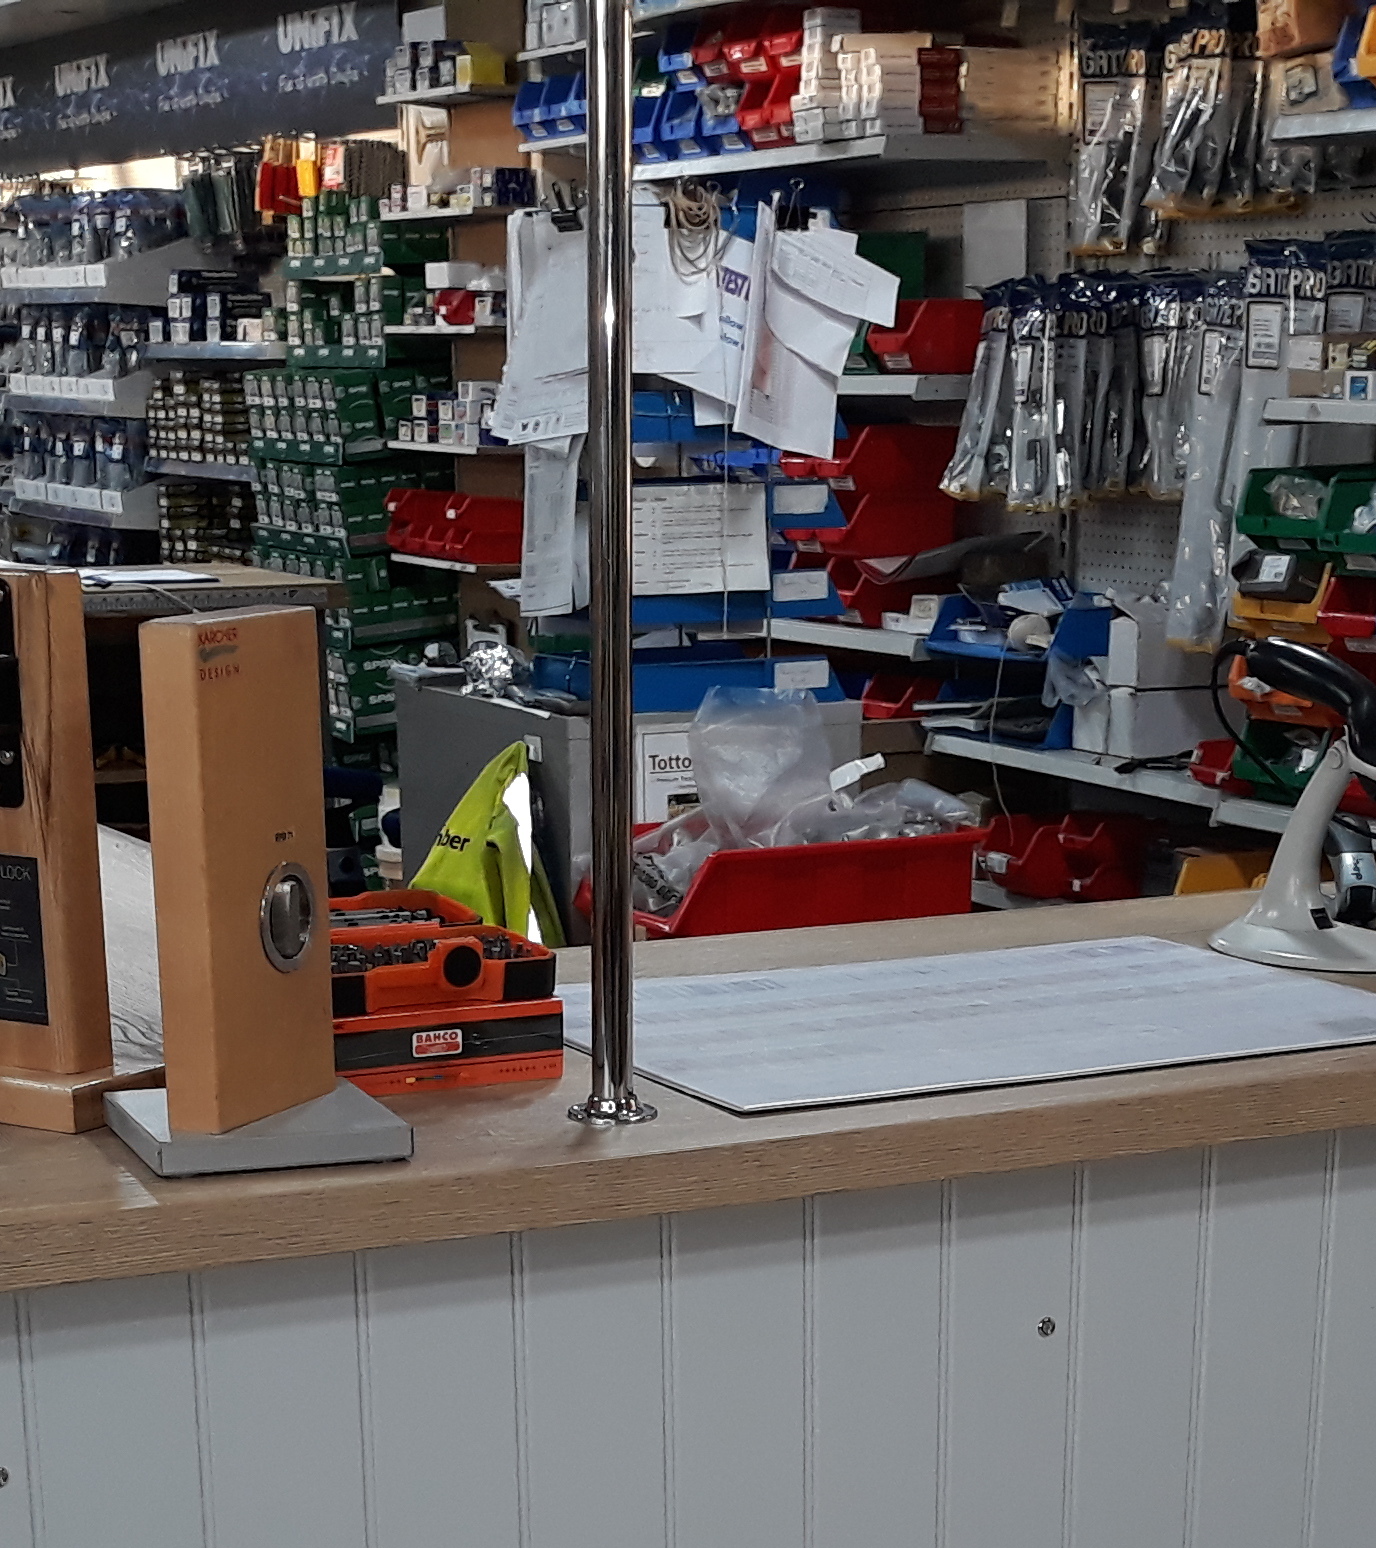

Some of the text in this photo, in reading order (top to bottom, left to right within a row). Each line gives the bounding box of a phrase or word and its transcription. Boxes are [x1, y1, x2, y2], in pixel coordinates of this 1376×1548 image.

[277, 3, 359, 54] UNIFIX
[199, 664, 240, 681] DESIGN
[0, 862, 32, 882] LOCK
[415, 1031, 459, 1044] BAHCO
